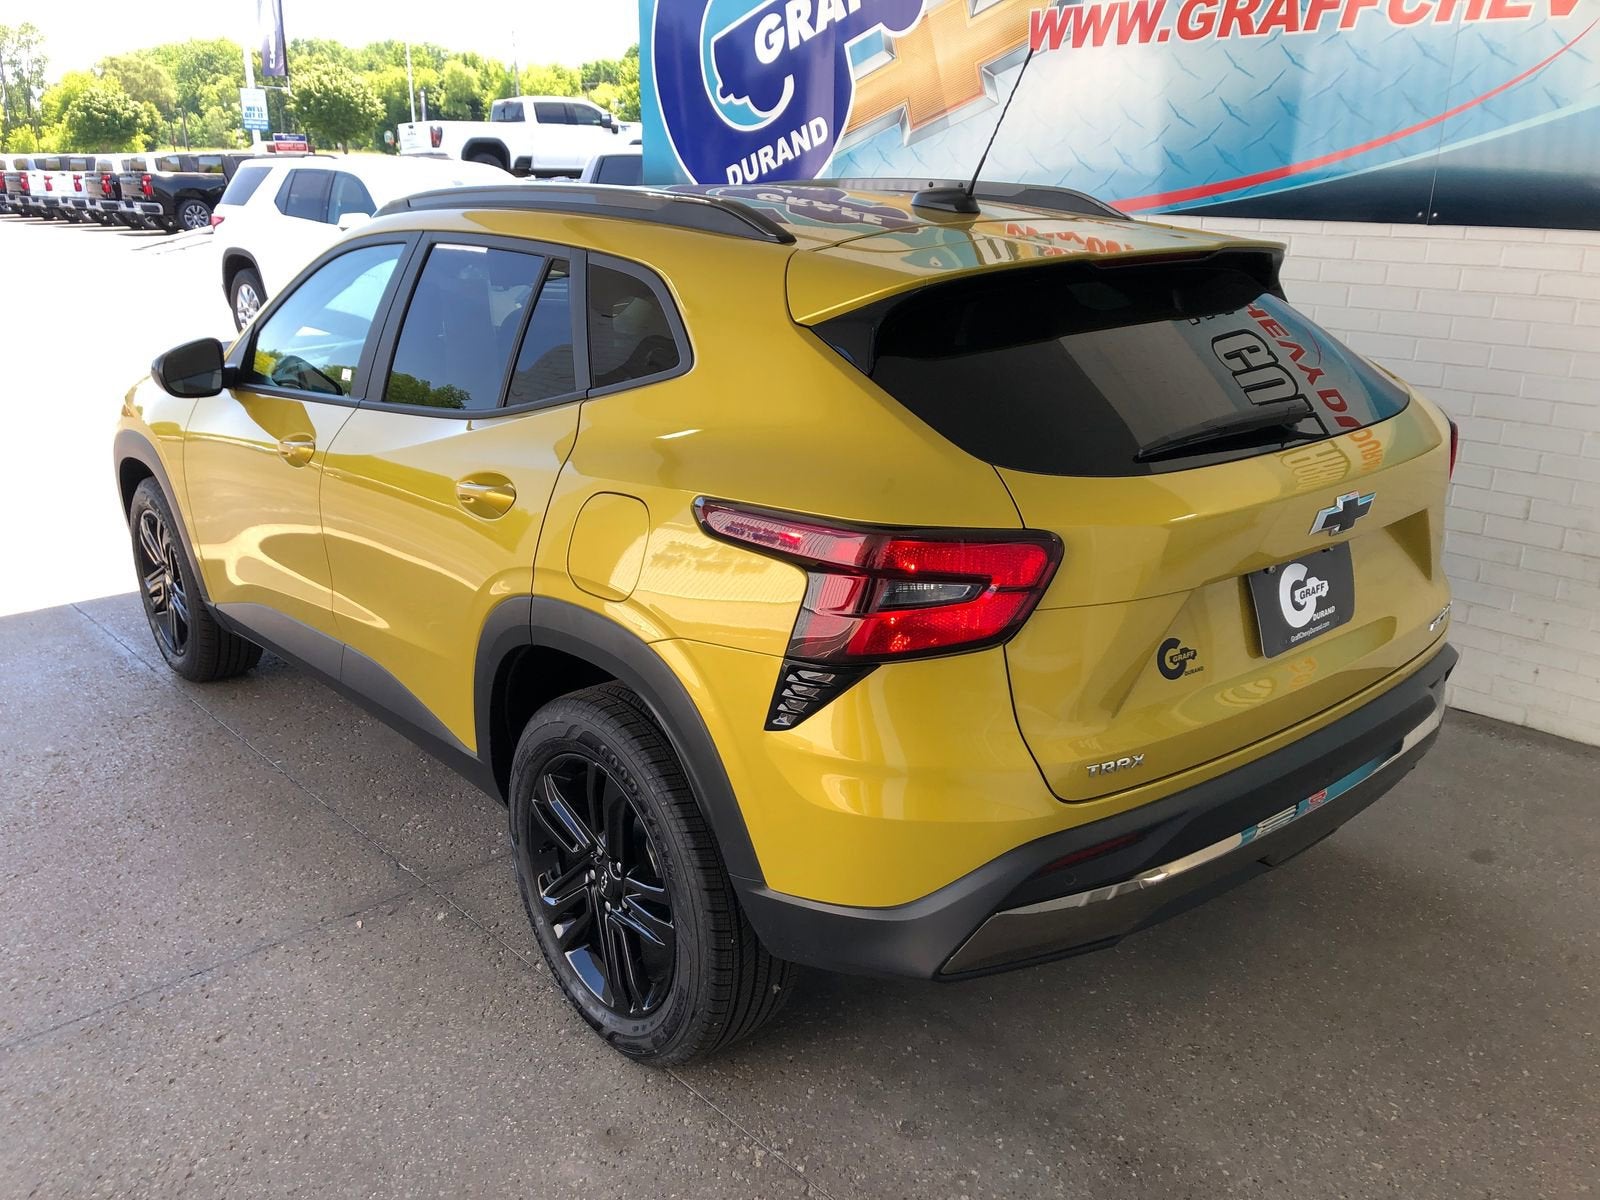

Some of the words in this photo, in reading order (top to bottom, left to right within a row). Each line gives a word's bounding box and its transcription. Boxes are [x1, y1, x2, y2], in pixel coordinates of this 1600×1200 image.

[726, 116, 829, 186] DURAND
[1300, 582, 1326, 600] GRAFF
[1313, 606, 1336, 621] DURAND
[1172, 651, 1195, 662] GRAFF
[1086, 753, 1145, 777] TRAX
